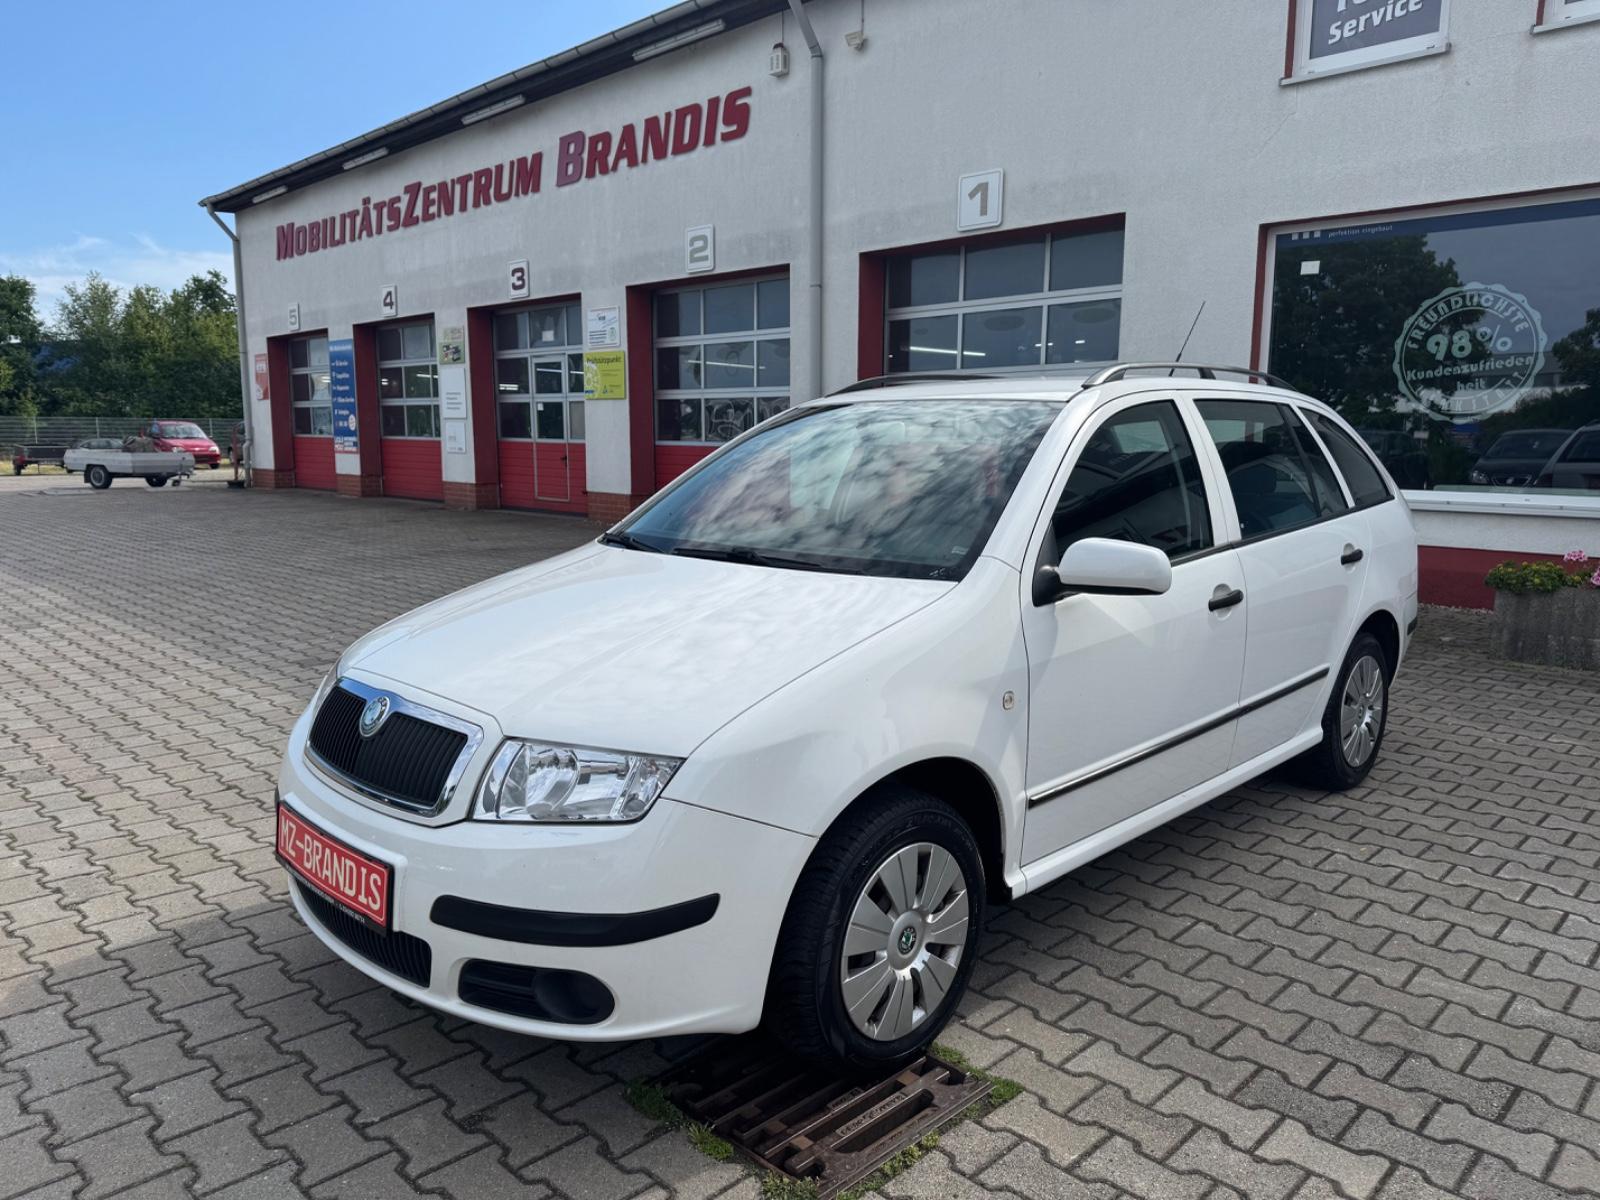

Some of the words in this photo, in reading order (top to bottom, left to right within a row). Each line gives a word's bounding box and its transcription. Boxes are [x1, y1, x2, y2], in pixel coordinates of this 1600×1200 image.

[1328, 0, 1423, 45] Service
[556, 85, 753, 188] BRANDIS
[967, 181, 989, 217] 1
[688, 233, 709, 264] 2
[510, 266, 526, 291] 3
[382, 290, 394, 310] 4
[288, 309, 298, 326] 5
[280, 815, 382, 911] MZ-BRANDIS
